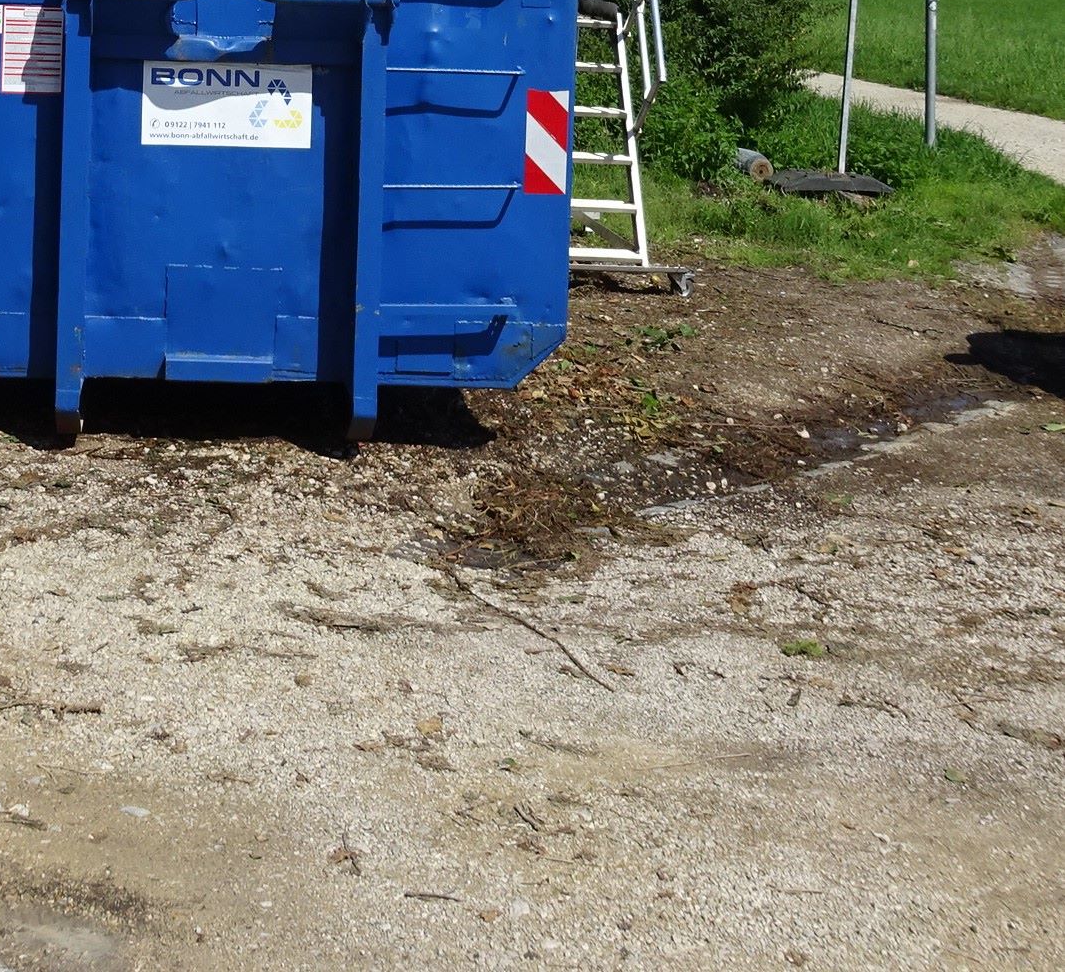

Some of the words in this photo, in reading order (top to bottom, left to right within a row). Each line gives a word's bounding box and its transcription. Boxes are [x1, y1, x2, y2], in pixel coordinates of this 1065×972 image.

[150, 67, 261, 88] BONN
[173, 89, 259, 97] ABFALLWIRTSCHAFT
[149, 132, 259, 141] www.bonn-abfallwirtschaft.de
